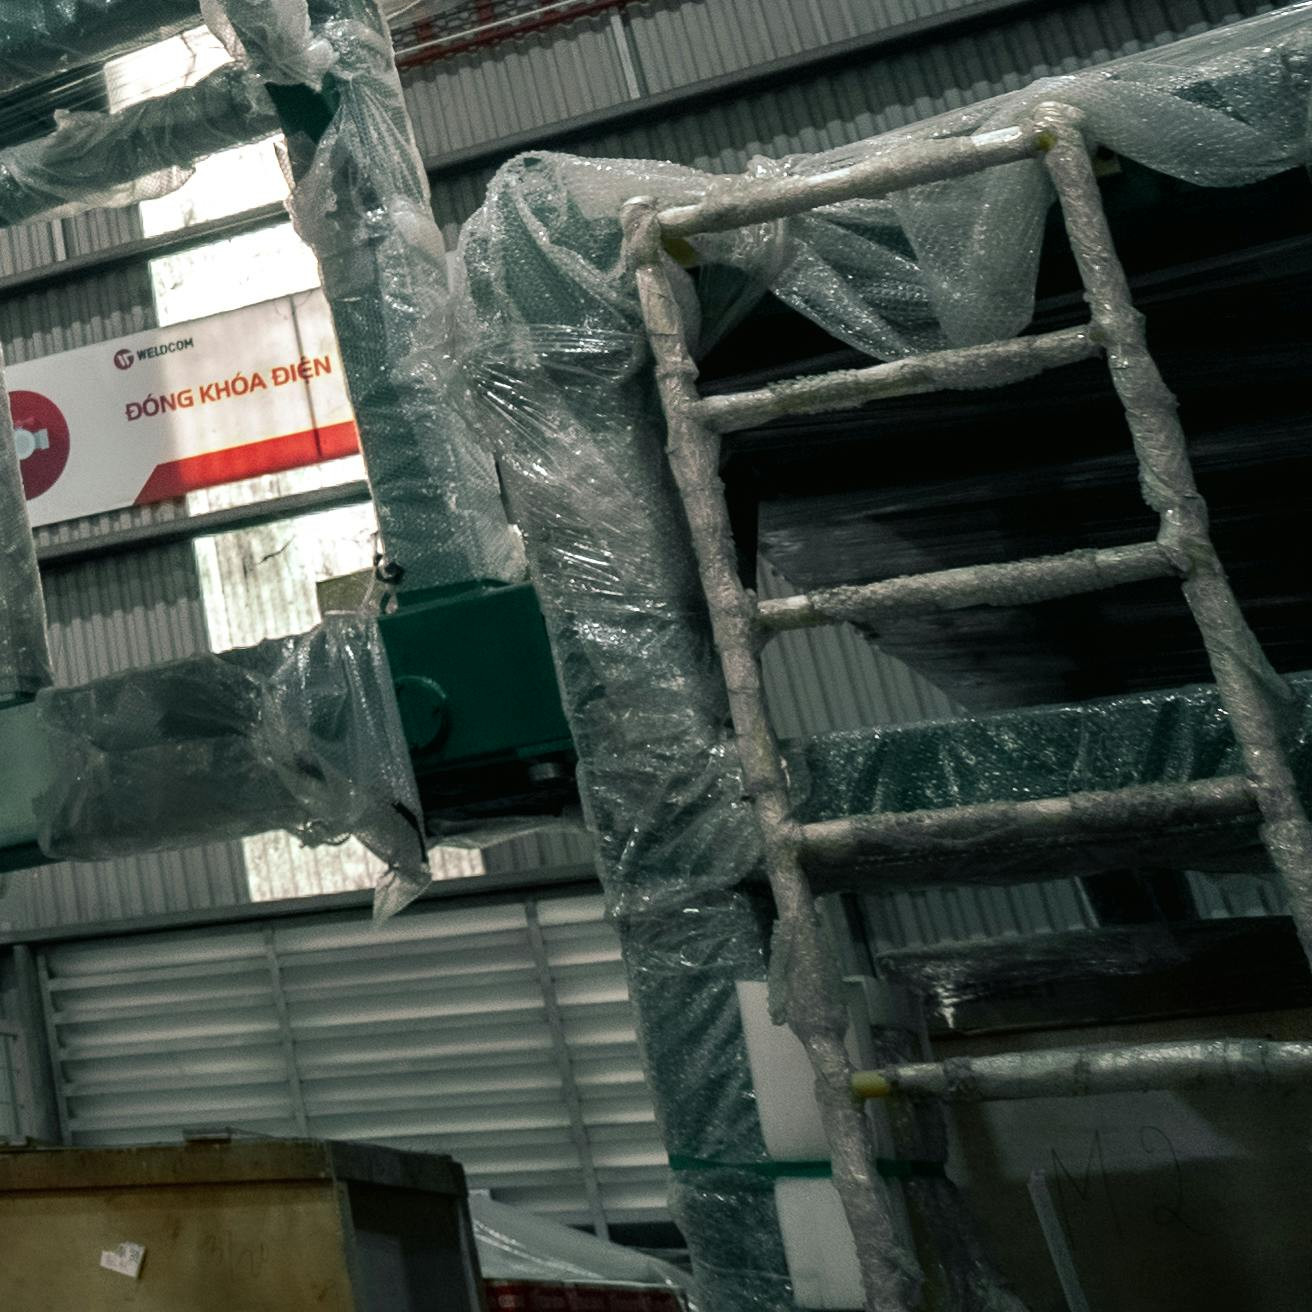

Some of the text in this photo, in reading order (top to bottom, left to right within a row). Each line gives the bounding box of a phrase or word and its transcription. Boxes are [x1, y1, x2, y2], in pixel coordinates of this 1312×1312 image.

[137, 338, 194, 361] WELDCOM
[125, 388, 195, 422] ĐÓNG
[199, 371, 267, 404] KHÓA
